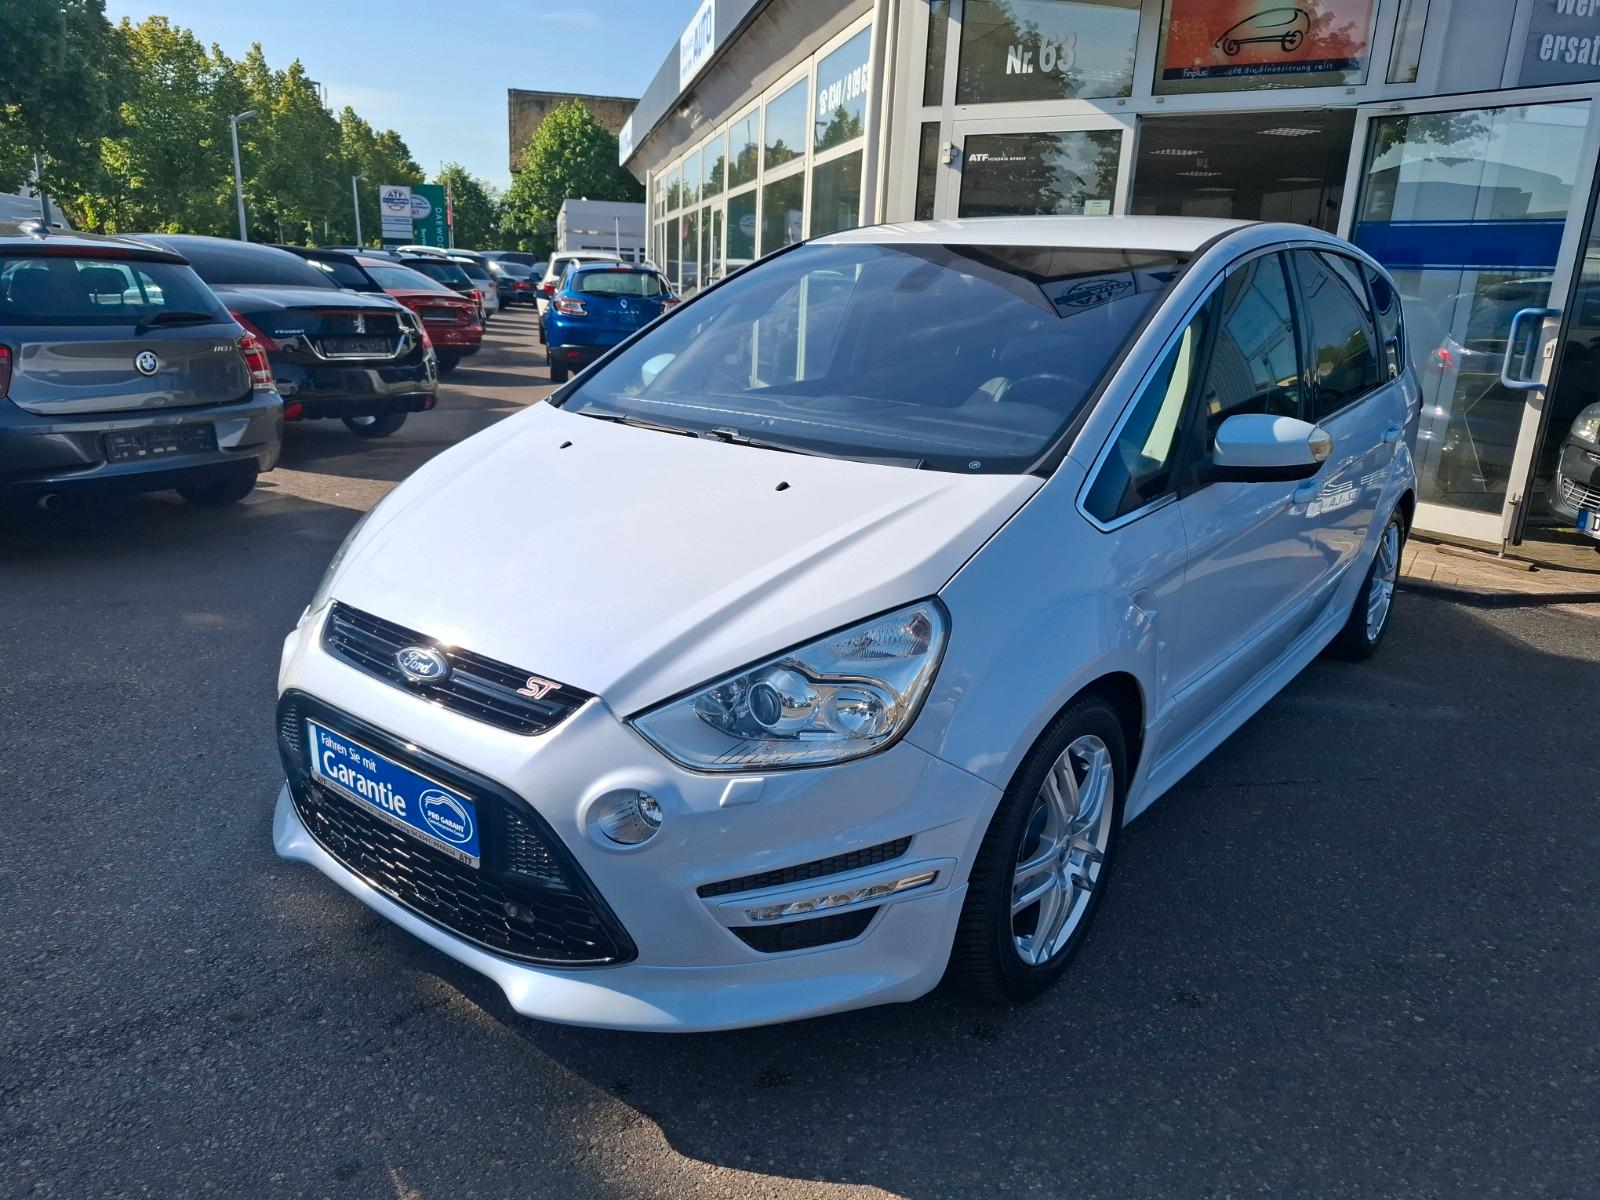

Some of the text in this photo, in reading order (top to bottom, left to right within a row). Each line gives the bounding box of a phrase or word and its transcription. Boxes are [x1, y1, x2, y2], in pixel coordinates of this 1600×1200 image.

[1006, 27, 1077, 74] Nr. 63
[1540, 34, 1600, 65] ersat
[968, 153, 988, 162] ATF
[403, 651, 434, 674] Ford
[516, 676, 562, 700] ST
[321, 732, 377, 773] Fahren Sie mit
[323, 751, 407, 817] Garantie
[427, 810, 465, 833] PRO GARANT
